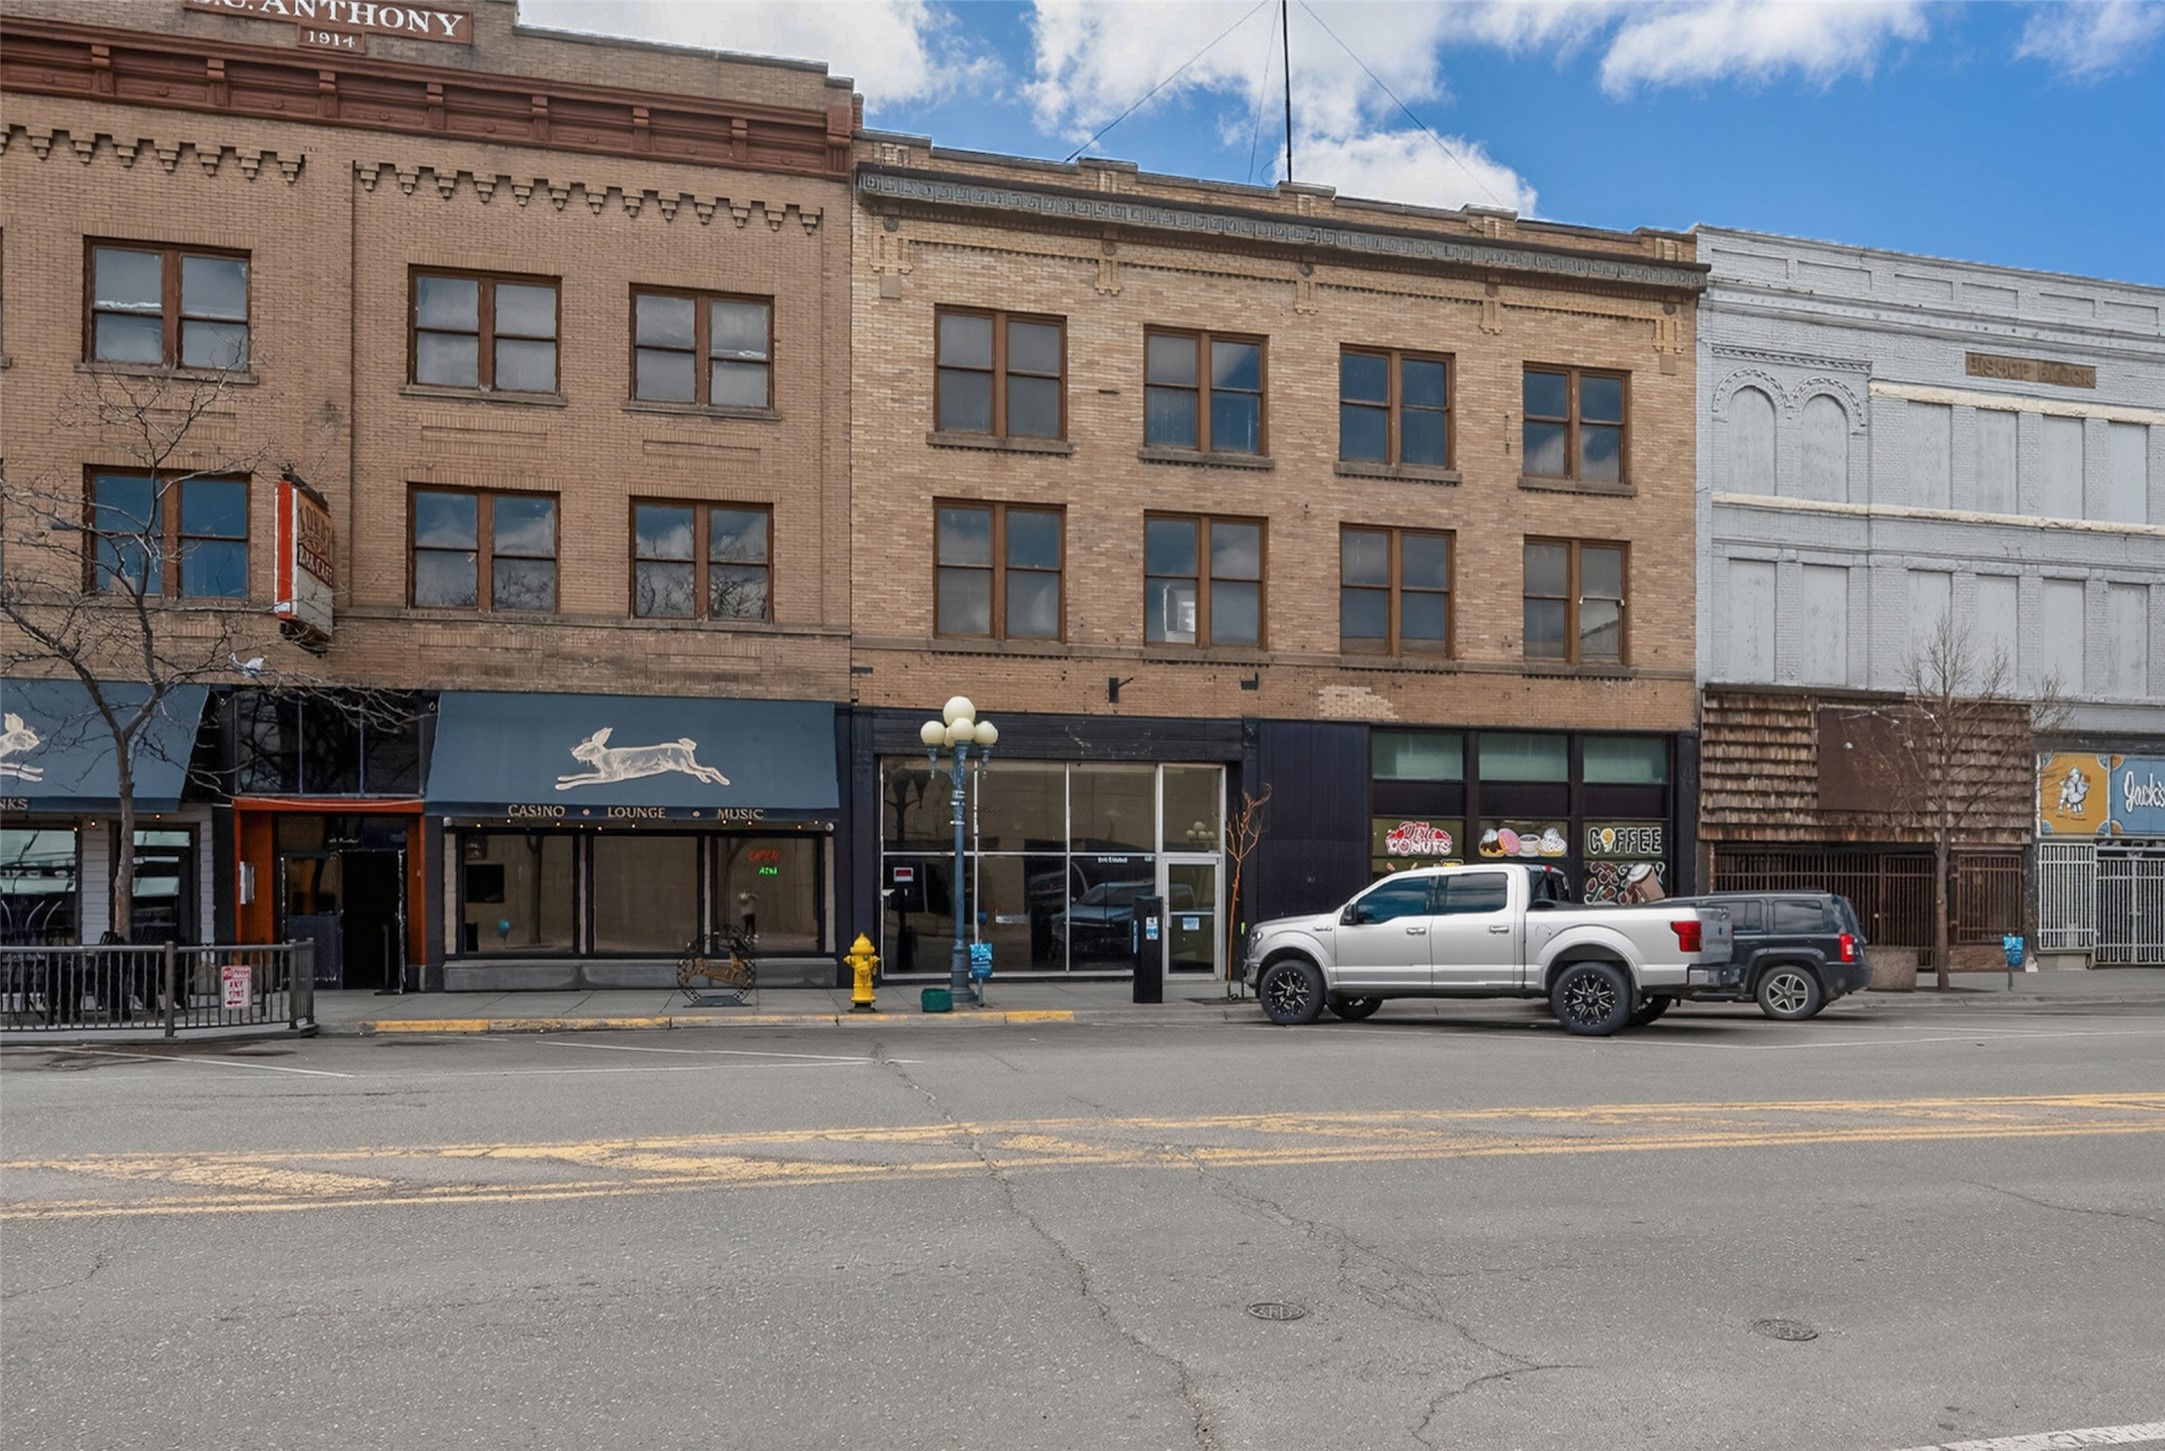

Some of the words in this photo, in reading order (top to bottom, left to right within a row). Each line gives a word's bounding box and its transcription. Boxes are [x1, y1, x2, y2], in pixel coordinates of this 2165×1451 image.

[260, 0, 463, 36] ANTHONY
[308, 30, 356, 48] 1914
[508, 804, 565, 818] CASINO
[608, 806, 666, 819] LOUNGE
[718, 808, 764, 820] MUSIC
[1386, 839, 1453, 856] DONUTS
[1588, 827, 1662, 854] COFFEE
